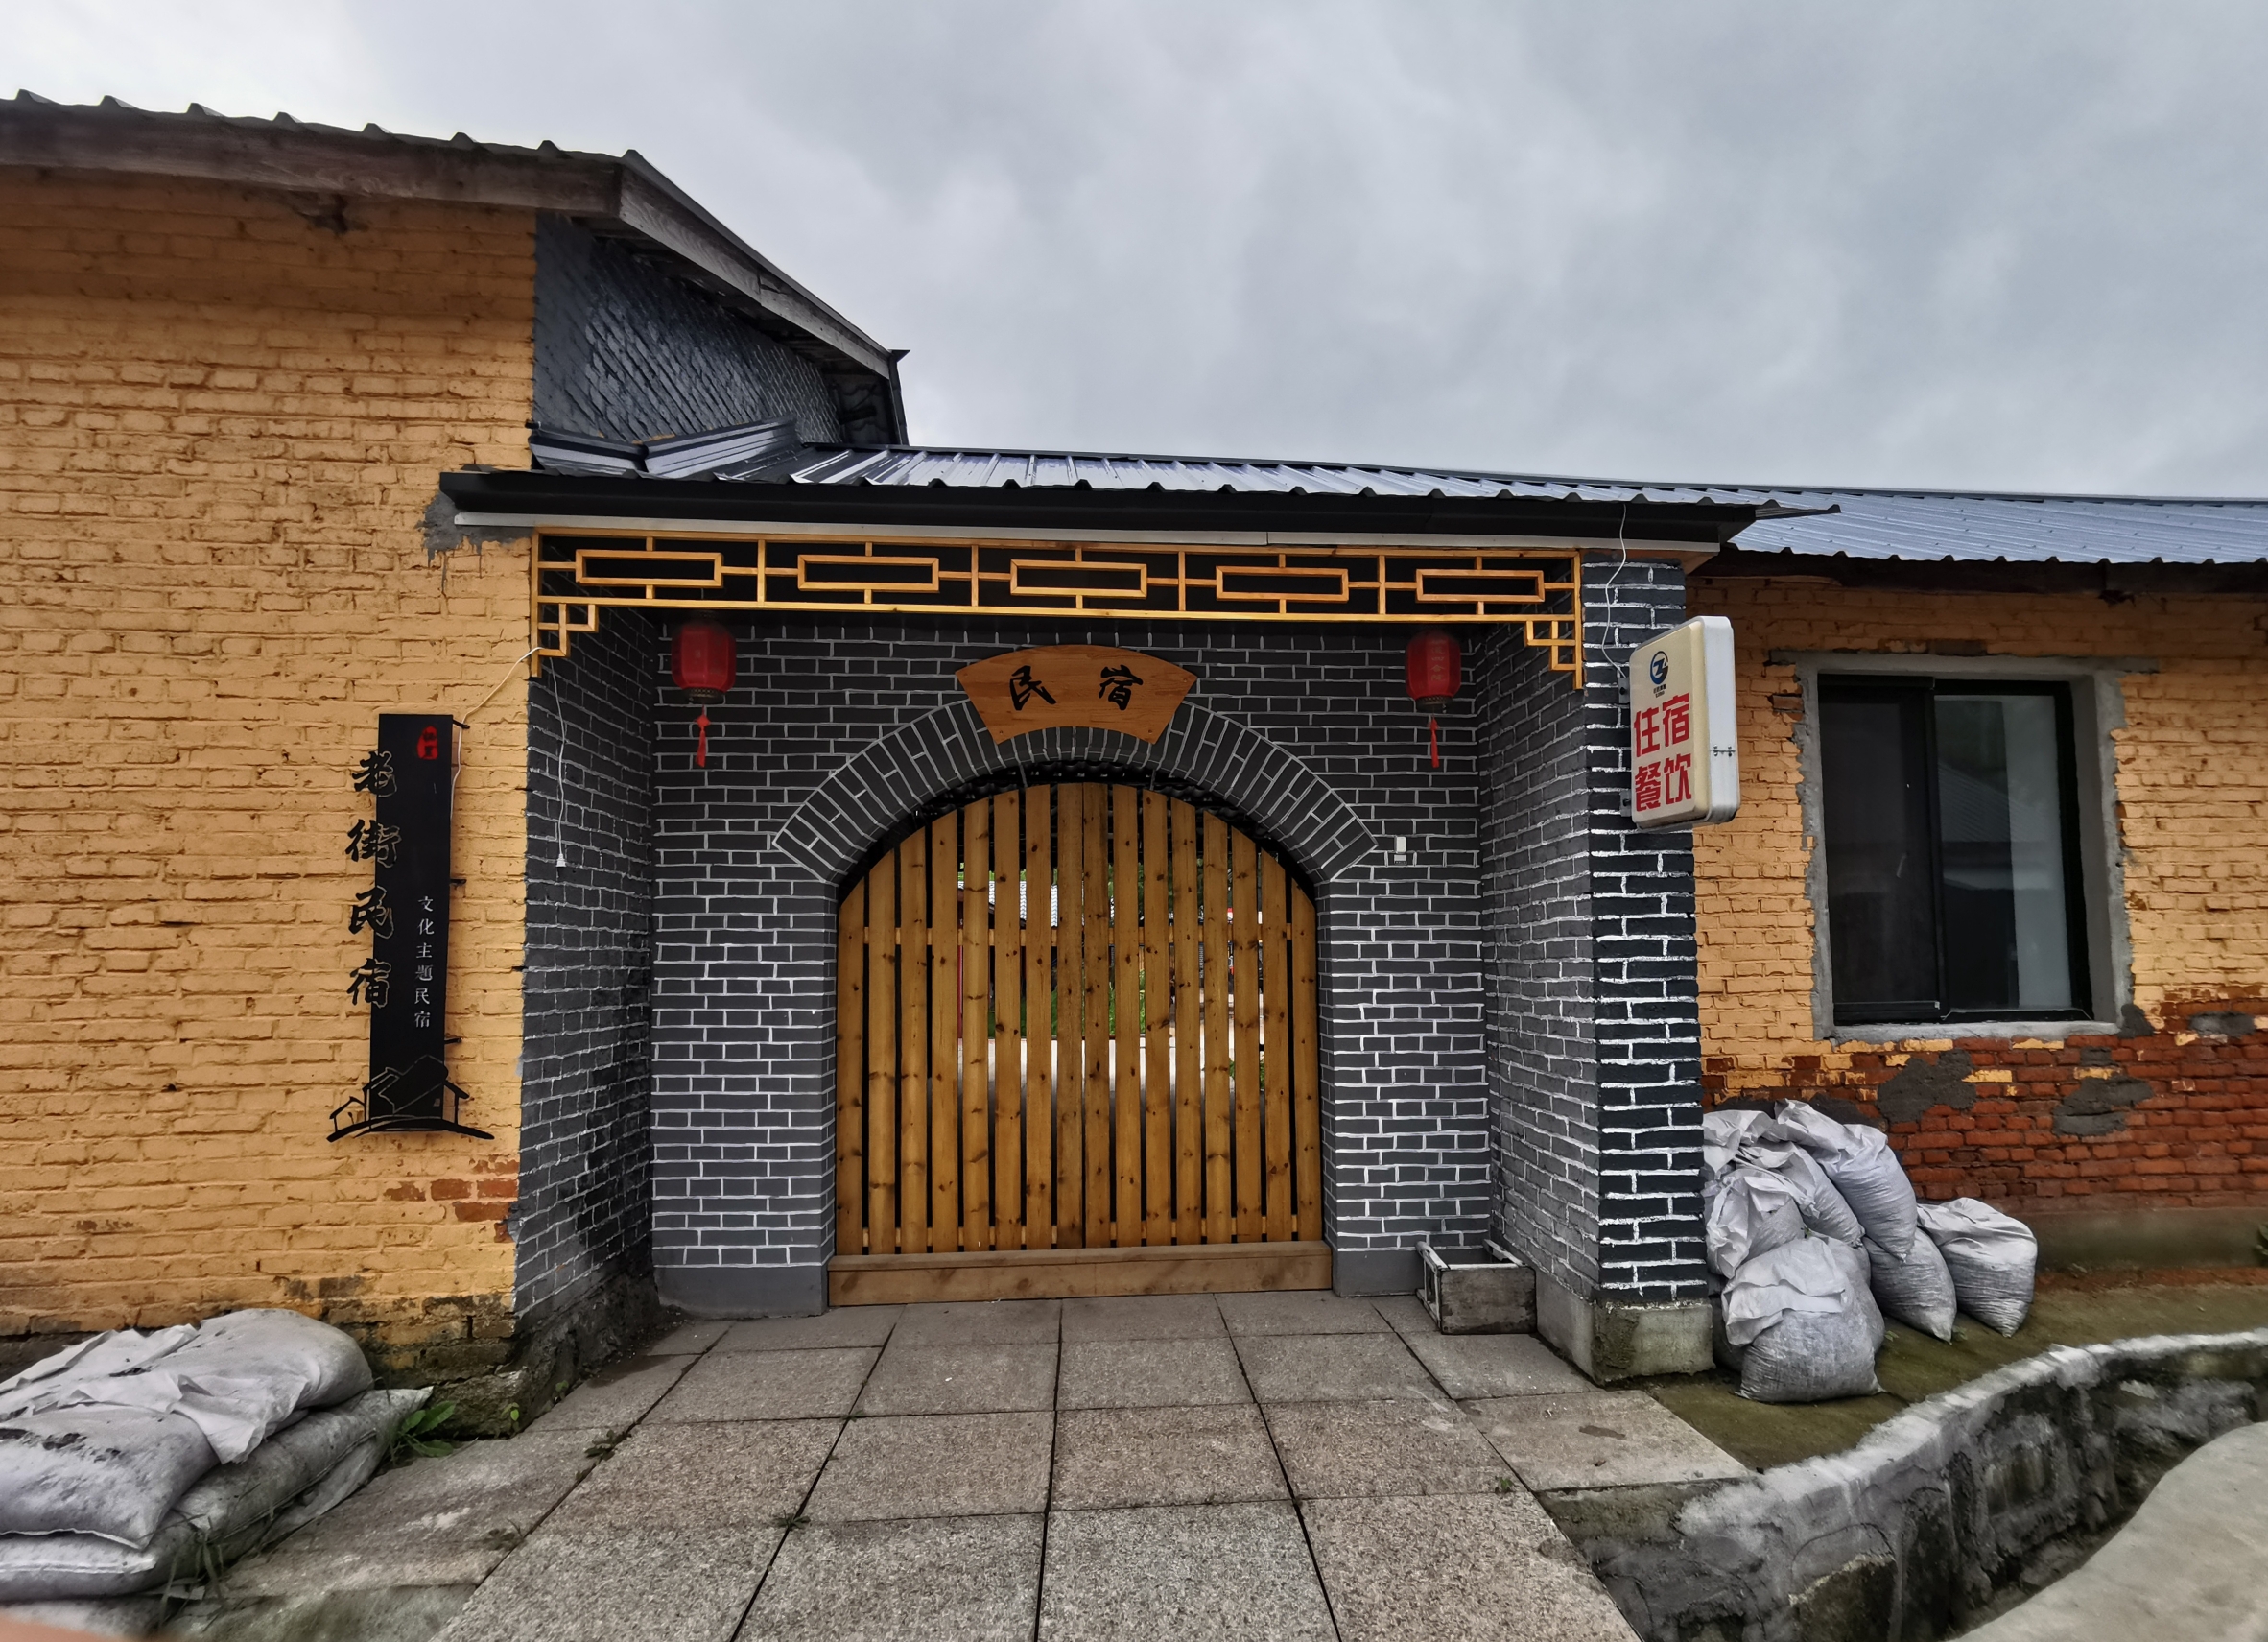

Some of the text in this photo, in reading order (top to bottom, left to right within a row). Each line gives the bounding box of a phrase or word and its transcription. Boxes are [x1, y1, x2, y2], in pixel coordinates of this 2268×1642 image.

[1009, 664, 1144, 711] 民宿
[1634, 692, 1689, 758] 住宿
[1635, 753, 1691, 812] 餐饮
[345, 750, 402, 1009] 老街民宿
[414, 895, 435, 1028] 文化主题民宿
